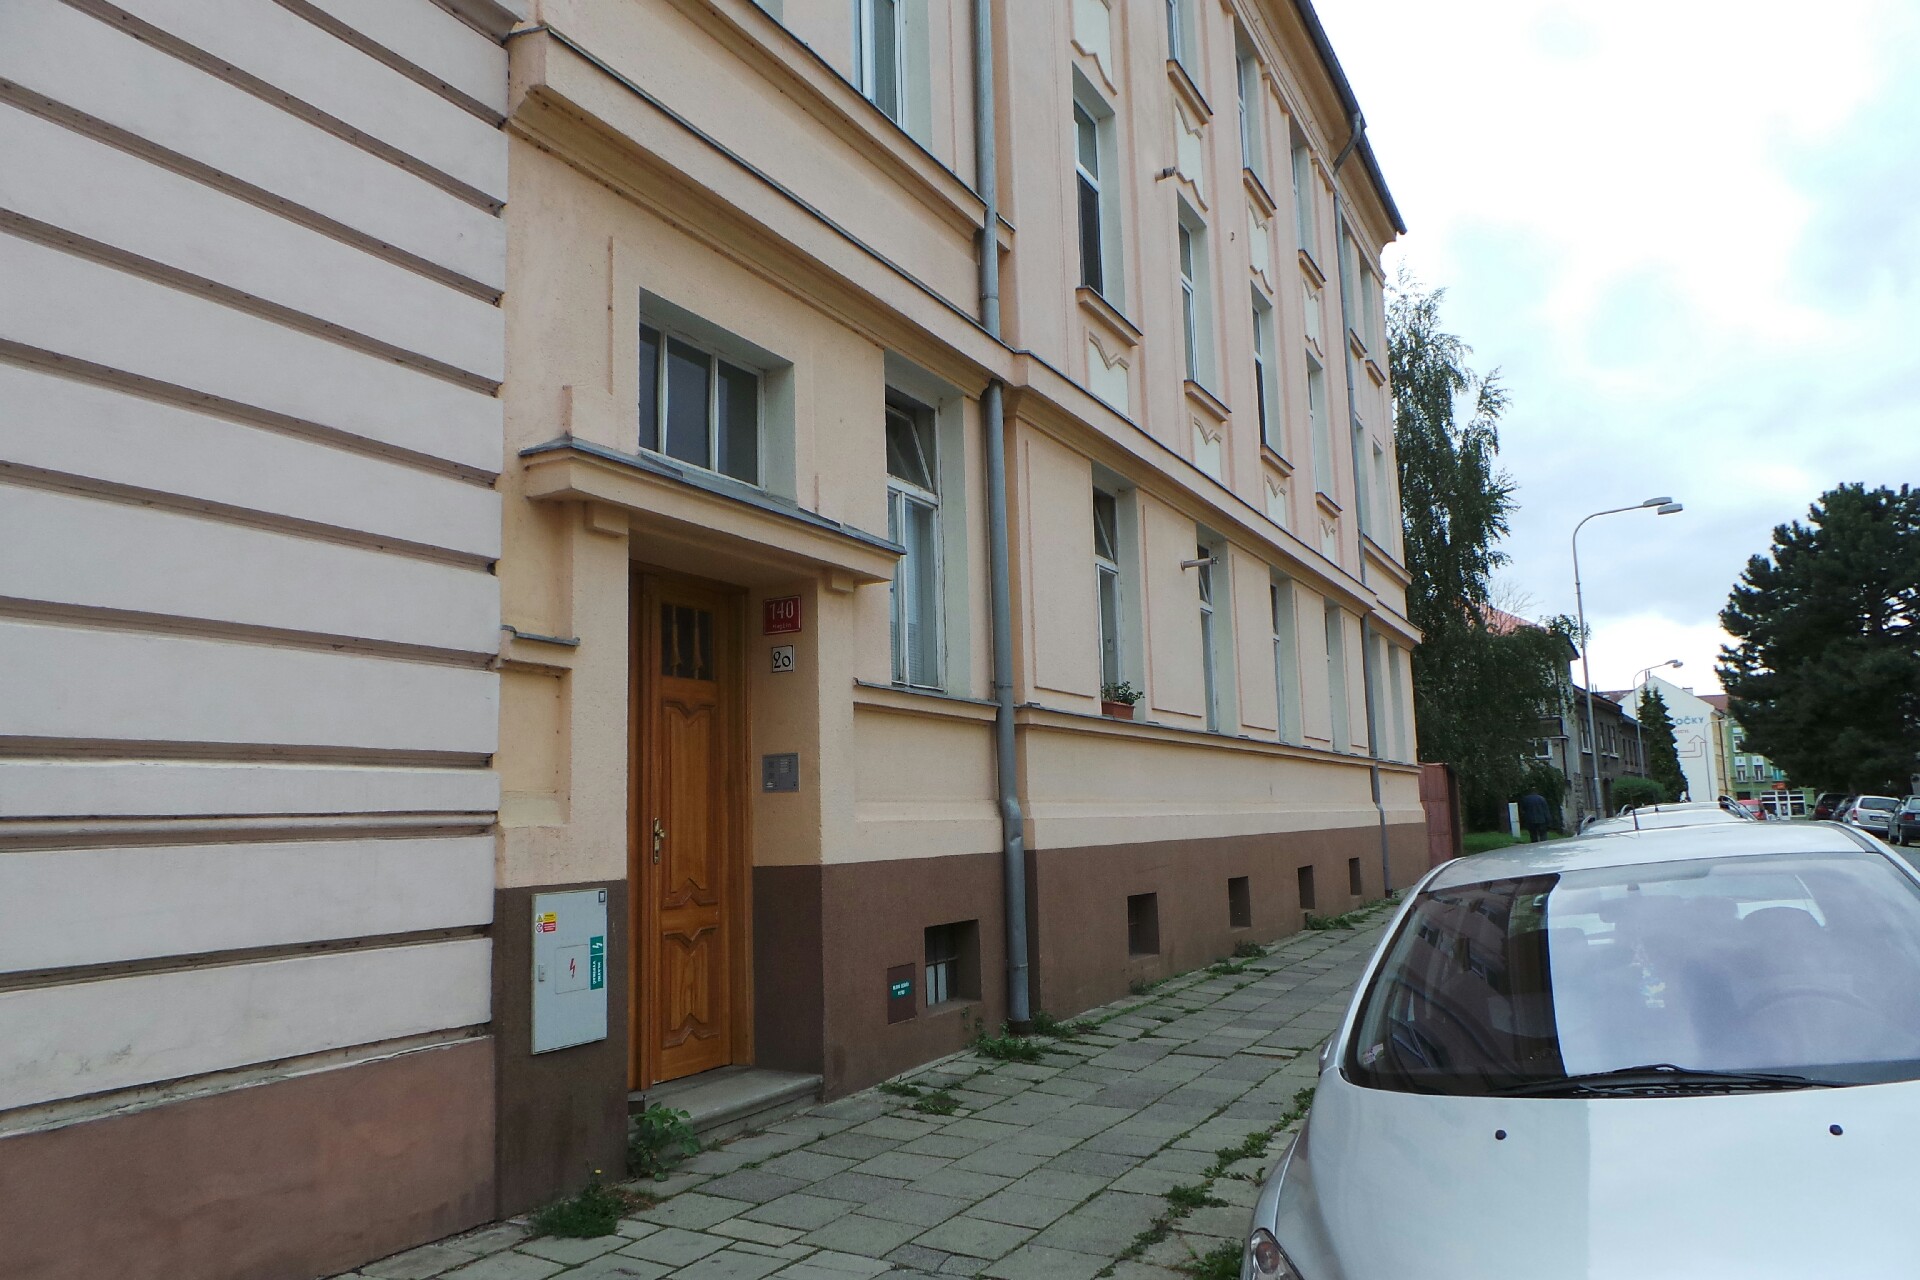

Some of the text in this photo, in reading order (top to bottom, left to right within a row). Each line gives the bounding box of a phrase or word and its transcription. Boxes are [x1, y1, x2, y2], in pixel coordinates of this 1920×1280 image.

[769, 601, 793, 620] 140
[773, 651, 791, 669] 20
[1673, 716, 1704, 725] OČKY
